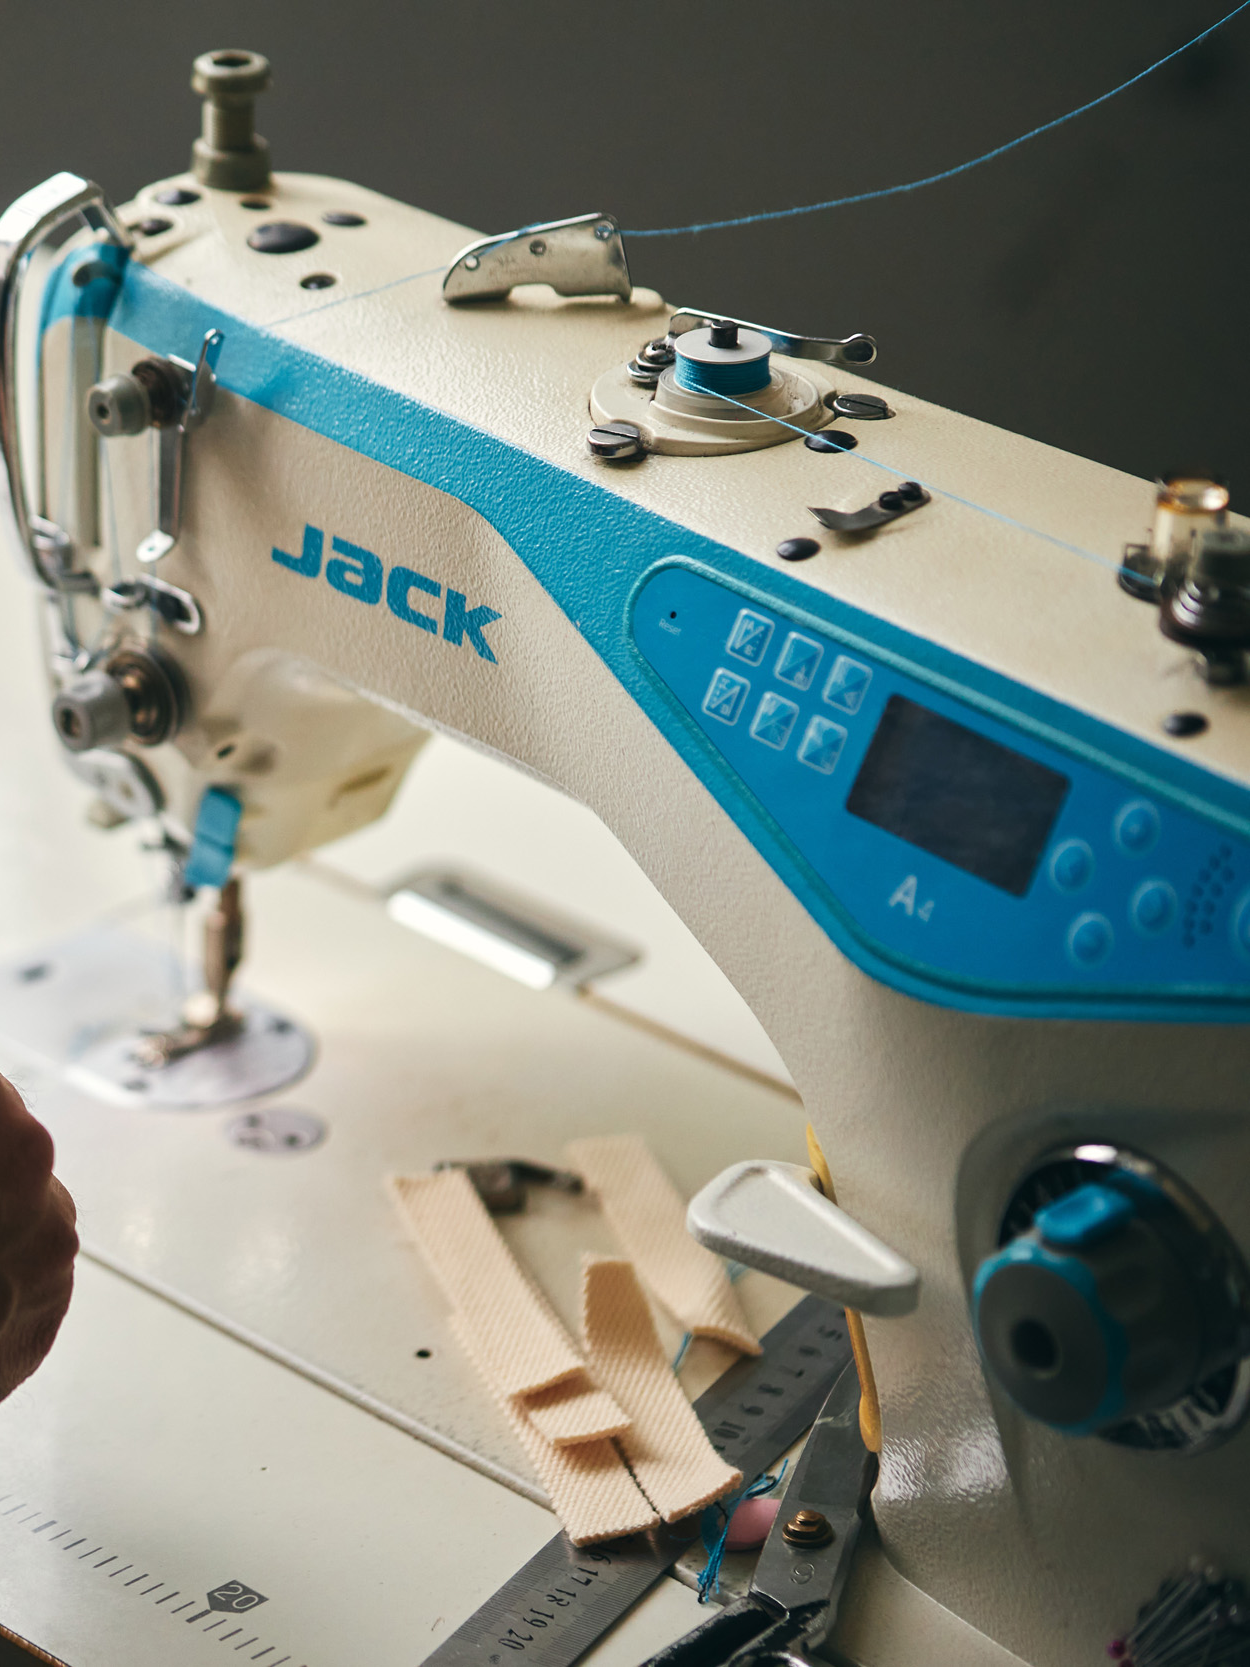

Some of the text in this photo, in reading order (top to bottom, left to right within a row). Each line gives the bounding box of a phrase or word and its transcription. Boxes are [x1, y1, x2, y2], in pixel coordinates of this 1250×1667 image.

[658, 618, 682, 636] Reset
[570, 1567, 599, 1587] 17
[213, 1584, 259, 1609] 20
[546, 1588, 577, 1607] 18
[523, 1608, 555, 1628] 19
[498, 1628, 534, 1650] 20
